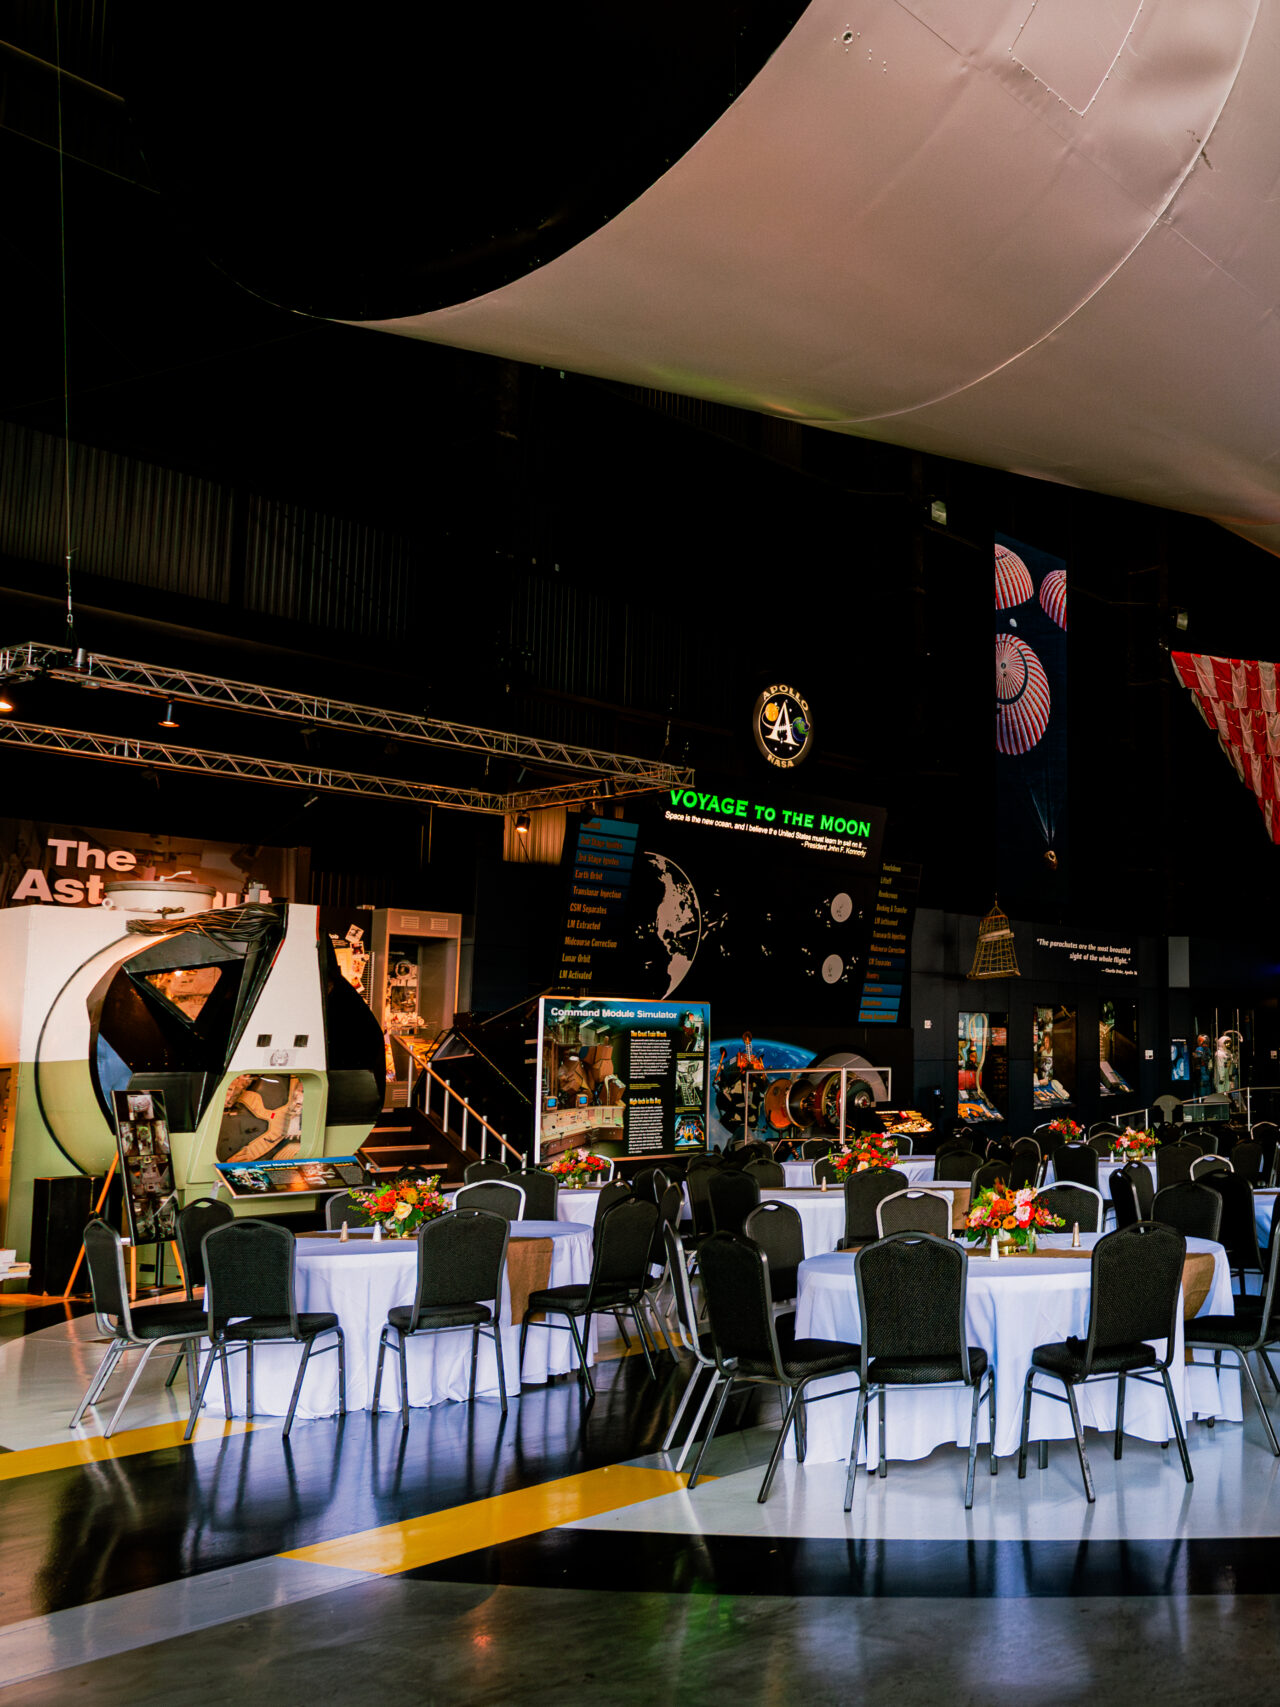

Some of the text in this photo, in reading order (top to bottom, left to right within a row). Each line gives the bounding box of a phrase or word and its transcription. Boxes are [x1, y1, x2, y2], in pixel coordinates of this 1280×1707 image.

[762, 684, 809, 711] APOLLO
[764, 700, 800, 747] A
[767, 754, 795, 768] NASA
[670, 789, 871, 838] VOYAGE TO THE MOON
[665, 810, 684, 821] Space
[685, 814, 690, 822] is
[691, 815, 701, 824] the
[701, 818, 714, 826] new
[714, 820, 733, 829] ocean,
[734, 822, 746, 831] and
[749, 824, 768, 834] believe
[768, 828, 778, 836] the
[778, 829, 795, 838] United
[796, 832, 811, 841] States
[812, 835, 824, 843] must
[824, 837, 836, 845] learn
[591, 837, 605, 848] Stage
[804, 840, 828, 851] President
[828, 845, 839, 853] John
[840, 846, 846, 854] F.
[846, 848, 867, 858] Kennedy
[47, 838, 137, 872] The
[578, 852, 587, 862] 3rd
[588, 853, 602, 864] Stage
[575, 869, 603, 881] Earth Orbit
[573, 885, 622, 899] Translunar Injection
[570, 903, 607, 915] CSM Separates
[567, 919, 601, 930] LM Extracted
[564, 936, 617, 949] Midcourse Correction
[1049, 940, 1078, 949] parachutes
[1088, 943, 1096, 951] the
[1109, 945, 1131, 955] beautiful
[562, 952, 591, 964] Lunar Orbit
[1069, 952, 1082, 961] sight
[1090, 954, 1098, 962] the
[1098, 955, 1113, 963] whole
[559, 969, 592, 980] LM Activated
[550, 1007, 677, 1019] Command Module Simulator
